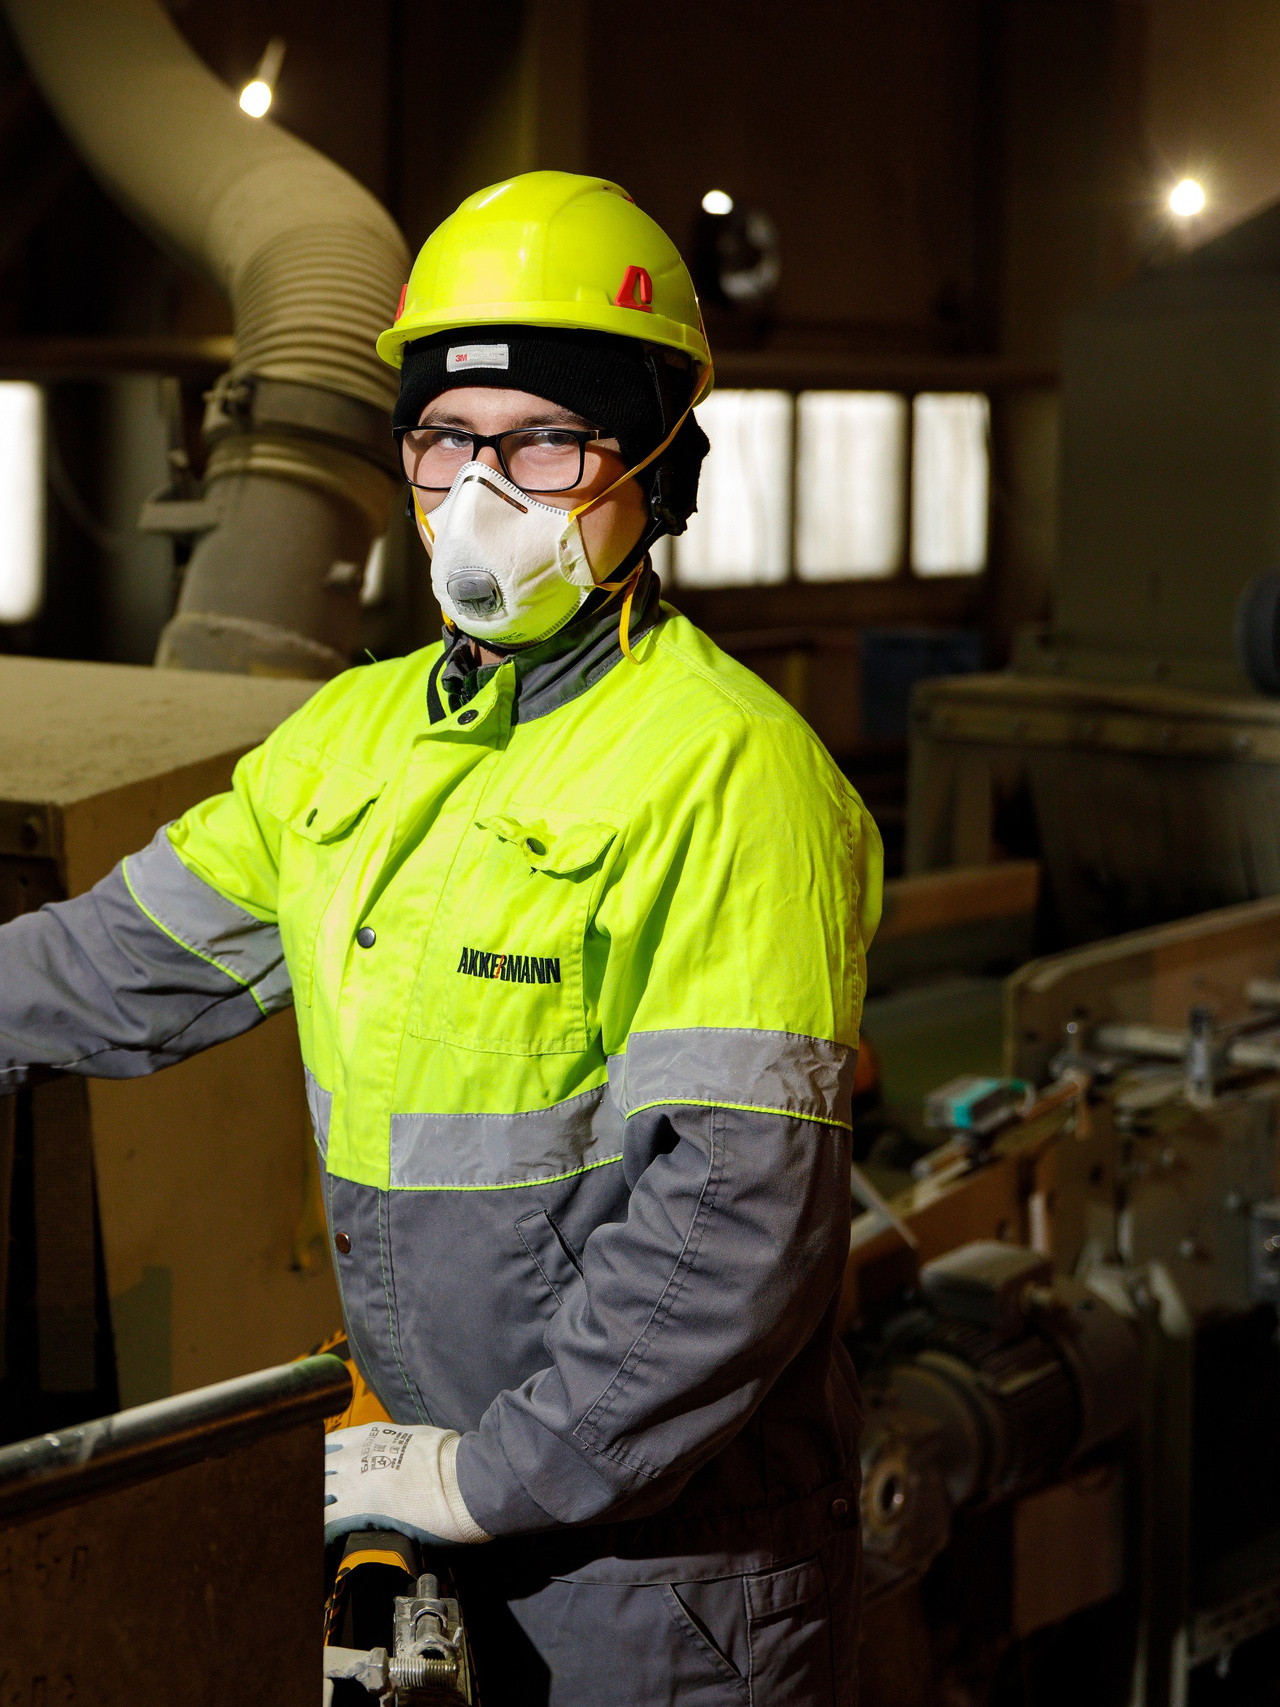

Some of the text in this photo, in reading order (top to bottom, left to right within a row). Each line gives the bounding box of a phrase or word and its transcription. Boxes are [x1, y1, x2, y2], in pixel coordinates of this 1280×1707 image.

[454, 353, 468, 363] 3M
[456, 946, 561, 984] AKKERMANN
[382, 1428, 397, 1436] 9
